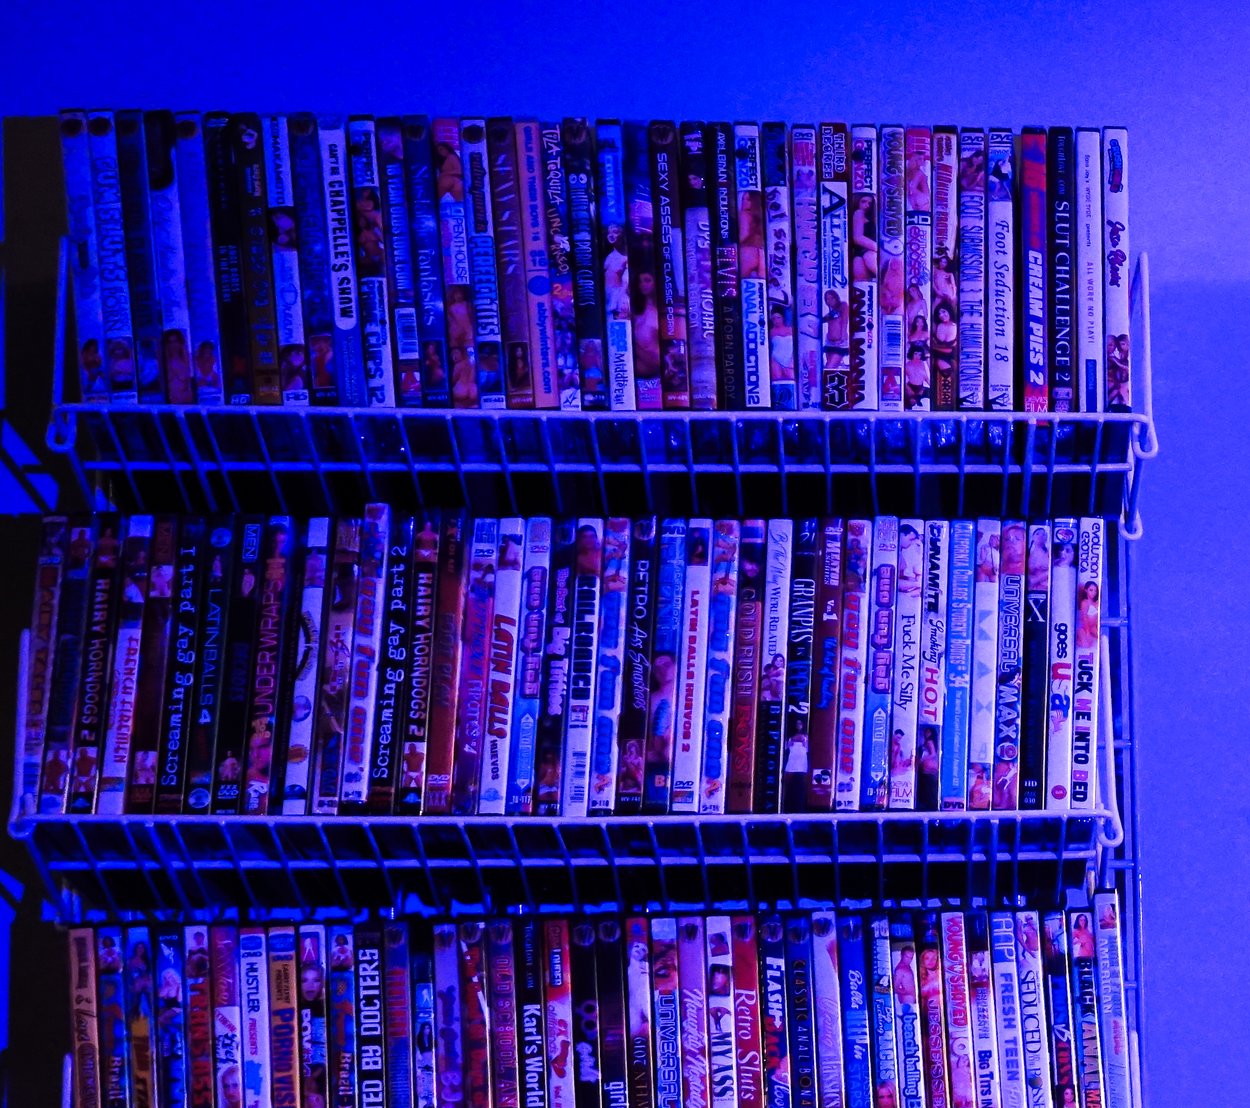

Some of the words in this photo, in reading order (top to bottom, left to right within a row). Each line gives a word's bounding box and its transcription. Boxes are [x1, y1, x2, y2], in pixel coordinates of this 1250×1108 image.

[330, 167, 340, 176] BE
[657, 153, 668, 190] SEXY
[823, 126, 834, 178] DEGREE
[834, 133, 845, 173] THIRD
[328, 180, 349, 272] CHAPPELLE'S
[659, 195, 672, 243] ASSES
[994, 220, 1009, 257] Foot
[1055, 201, 1069, 248] SLUT
[453, 218, 466, 283] PENTHOUSE
[663, 246, 671, 260] OF
[337, 277, 353, 319] SHOW
[664, 263, 673, 304] CLASSIC
[994, 261, 1010, 337] Seduction
[1028, 250, 1042, 316] CREAM
[666, 307, 675, 335] PORN
[1056, 252, 1070, 366] CHALLENGE
[994, 344, 1009, 362] 18
[1029, 321, 1043, 366] PIES
[1030, 370, 1043, 385] 2
[1056, 372, 1069, 381] 2
[392, 546, 407, 556] 2
[390, 564, 407, 610] part
[415, 573, 432, 628] HAIRY
[388, 620, 407, 661] gay
[900, 614, 915, 650] Fuck
[1054, 623, 1069, 658] goes
[410, 633, 432, 719] HORNDOGS
[900, 654, 914, 678] Me
[895, 682, 913, 711] Silly
[1076, 698, 1092, 721] ME
[373, 668, 404, 779] Screaming
[409, 725, 423, 736] 2
[1074, 726, 1091, 764] INTO
[1073, 770, 1088, 802] BED
[246, 962, 260, 1013] HUSTLER
[358, 949, 380, 1036] DOCTERS
[1000, 973, 1016, 1029] FRESH
[523, 1004, 542, 1054] Karl's
[735, 989, 756, 1040] Retro
[902, 1014, 917, 1055] beach
[361, 1045, 382, 1070] BY
[737, 1048, 759, 1100] Sluts
[904, 1057, 919, 1096] balling
[1004, 1037, 1019, 1081] TEEN
[525, 1059, 544, 1107] World
